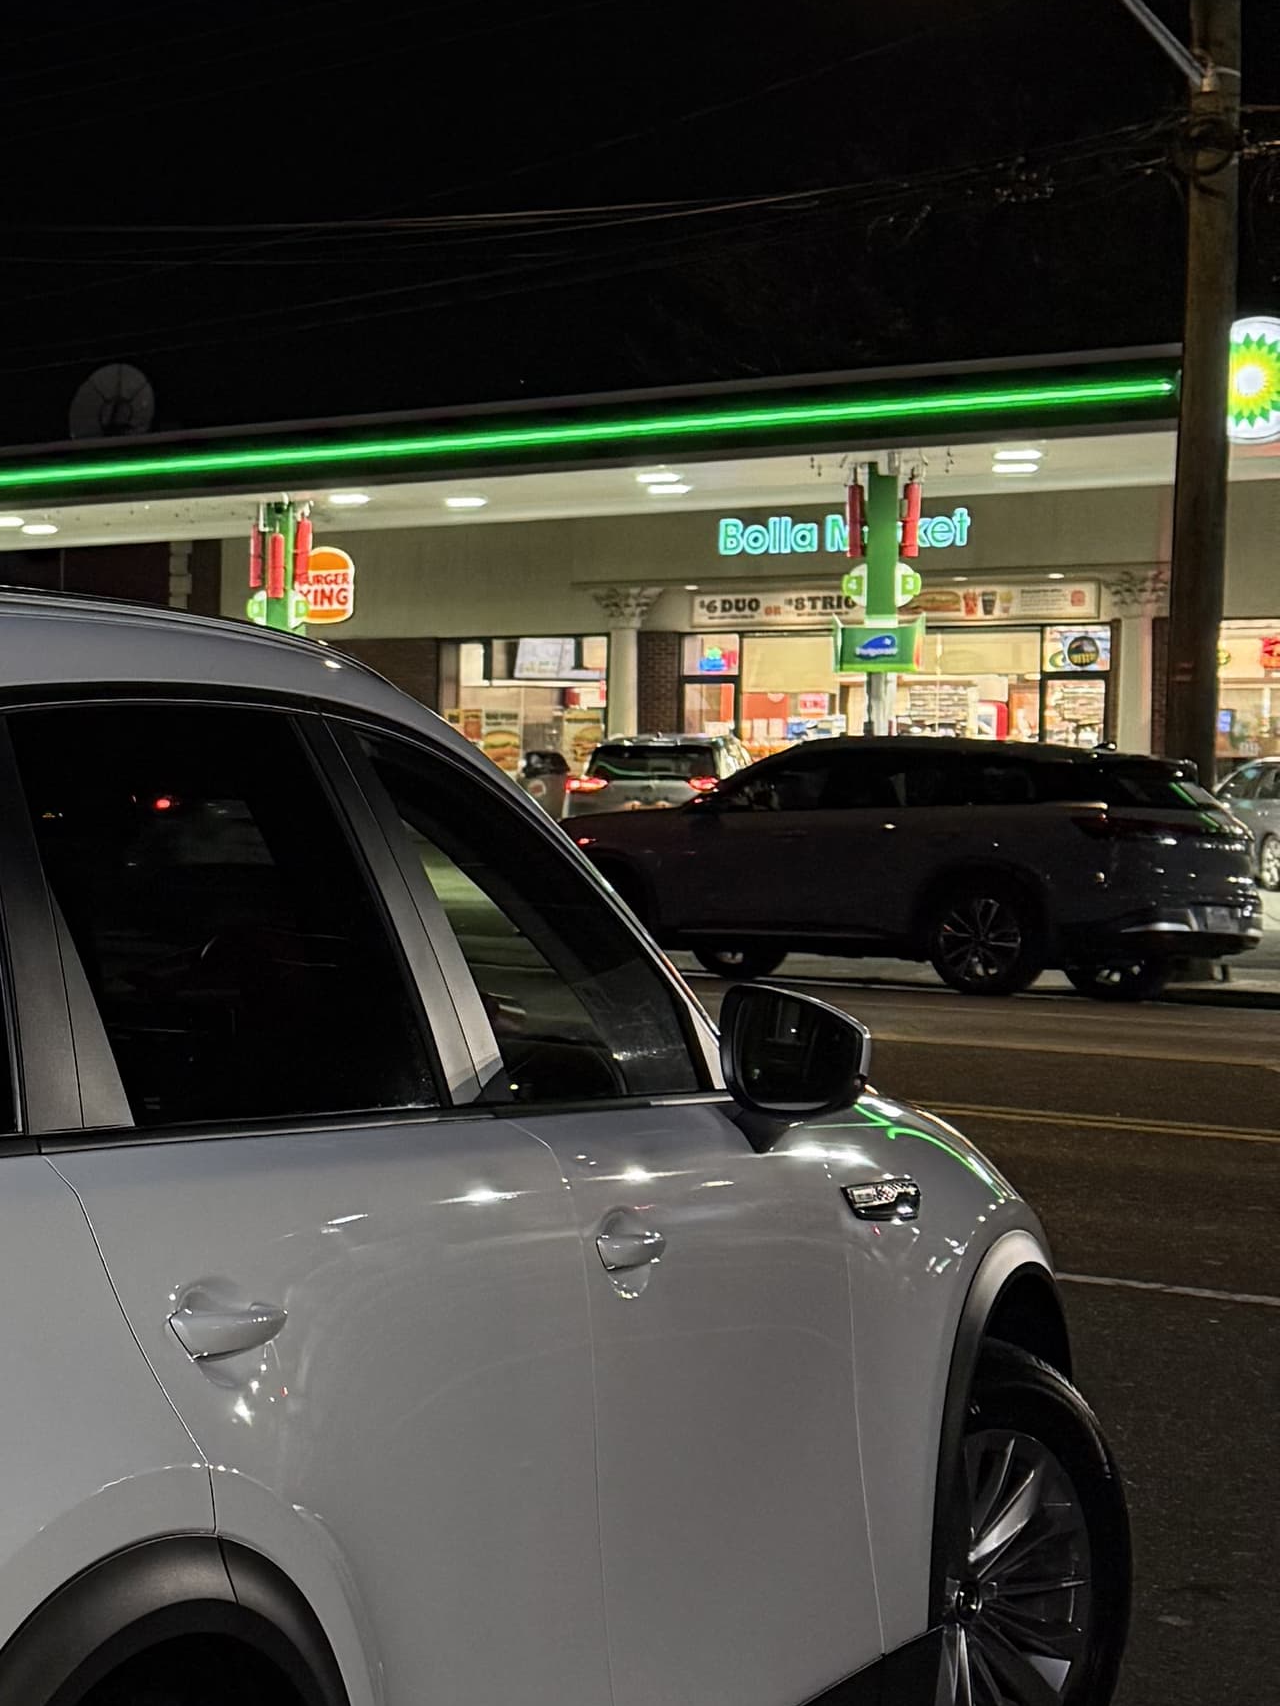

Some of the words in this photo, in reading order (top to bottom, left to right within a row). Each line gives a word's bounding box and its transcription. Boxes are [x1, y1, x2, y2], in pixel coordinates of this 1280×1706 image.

[719, 516, 818, 555] Bolla
[825, 507, 971, 551] Mket
[720, 597, 761, 613] DUO
